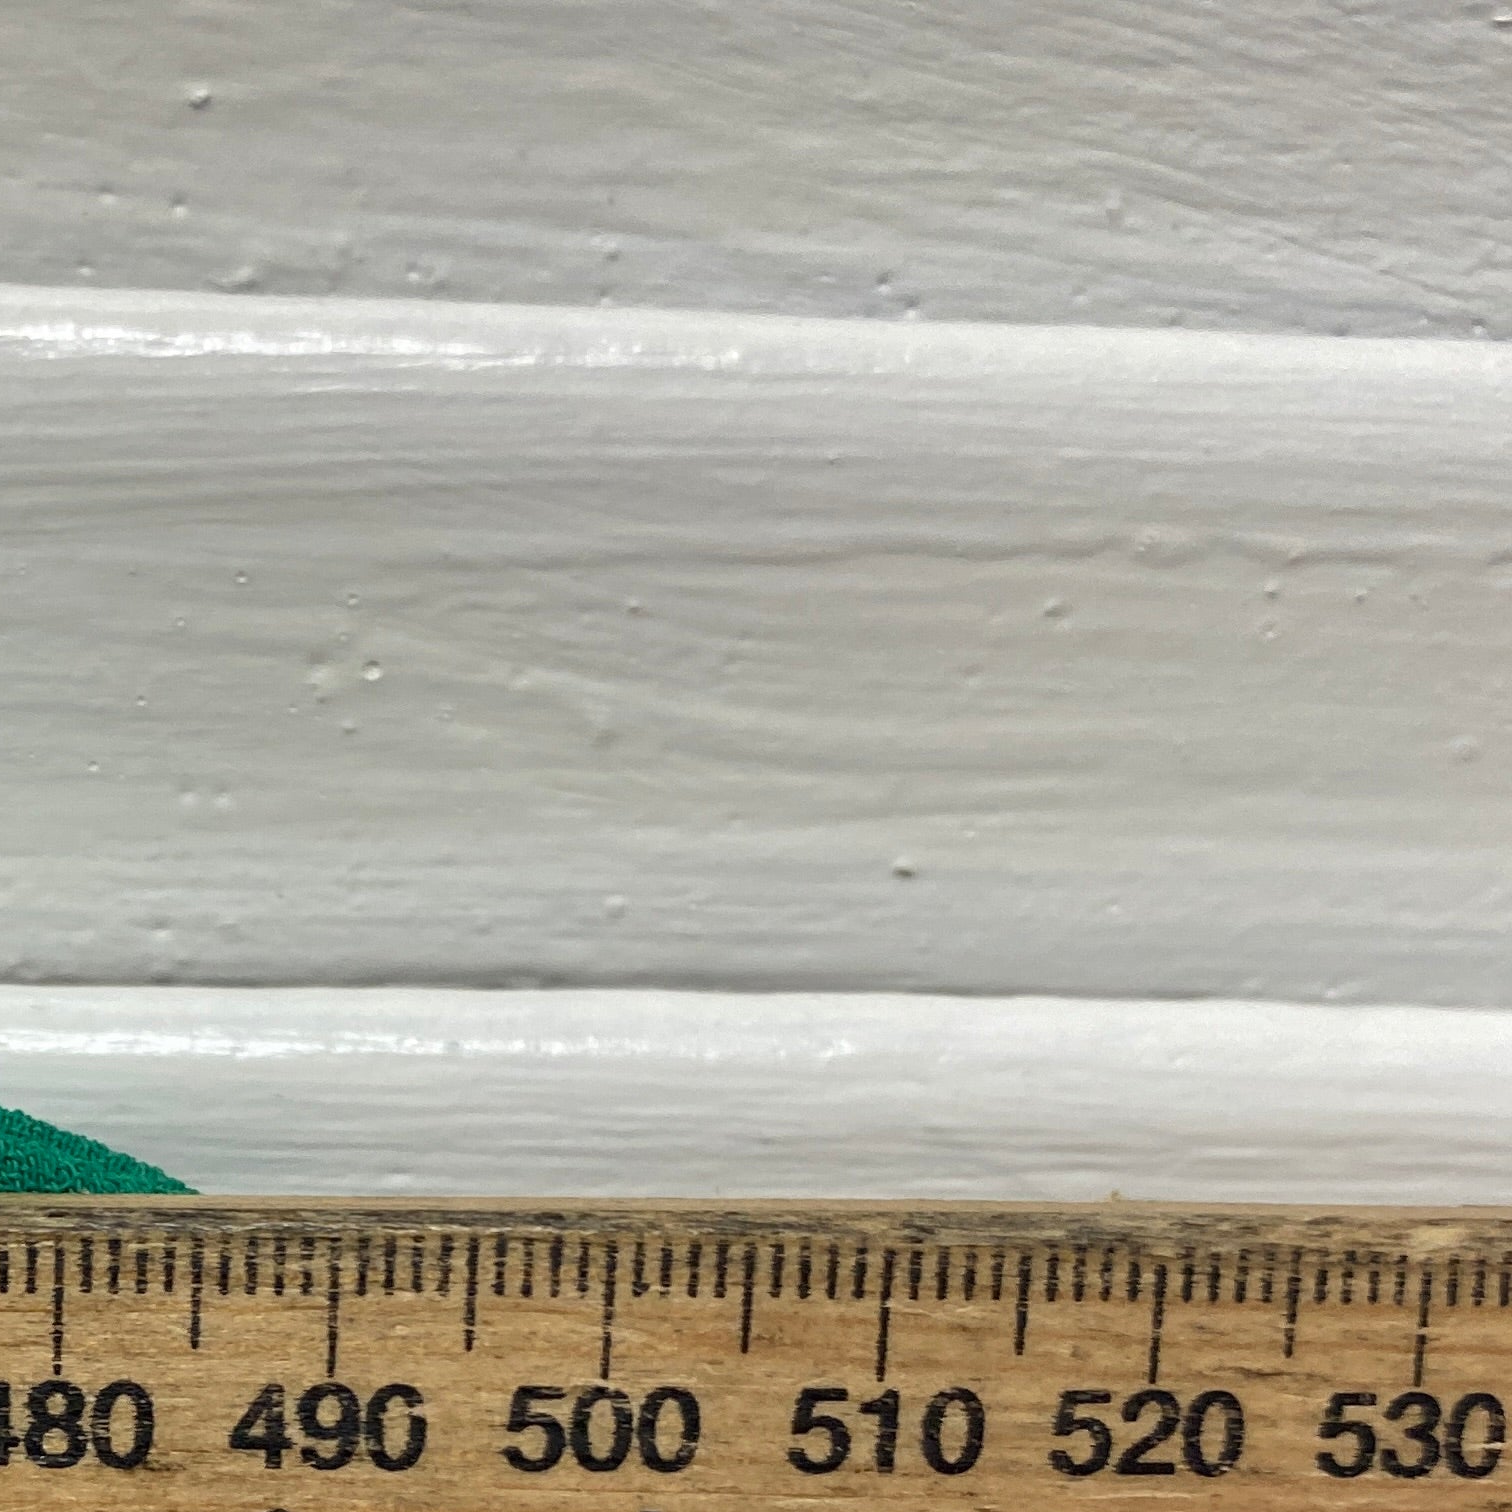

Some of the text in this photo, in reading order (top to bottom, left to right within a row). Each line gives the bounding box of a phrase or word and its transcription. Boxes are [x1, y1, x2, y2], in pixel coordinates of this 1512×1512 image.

[228, 1382, 428, 1472] 490
[496, 1385, 701, 1473] 500
[786, 1386, 986, 1476] 510
[1048, 1389, 1245, 1478] 520
[1315, 1391, 1506, 1479] 530
